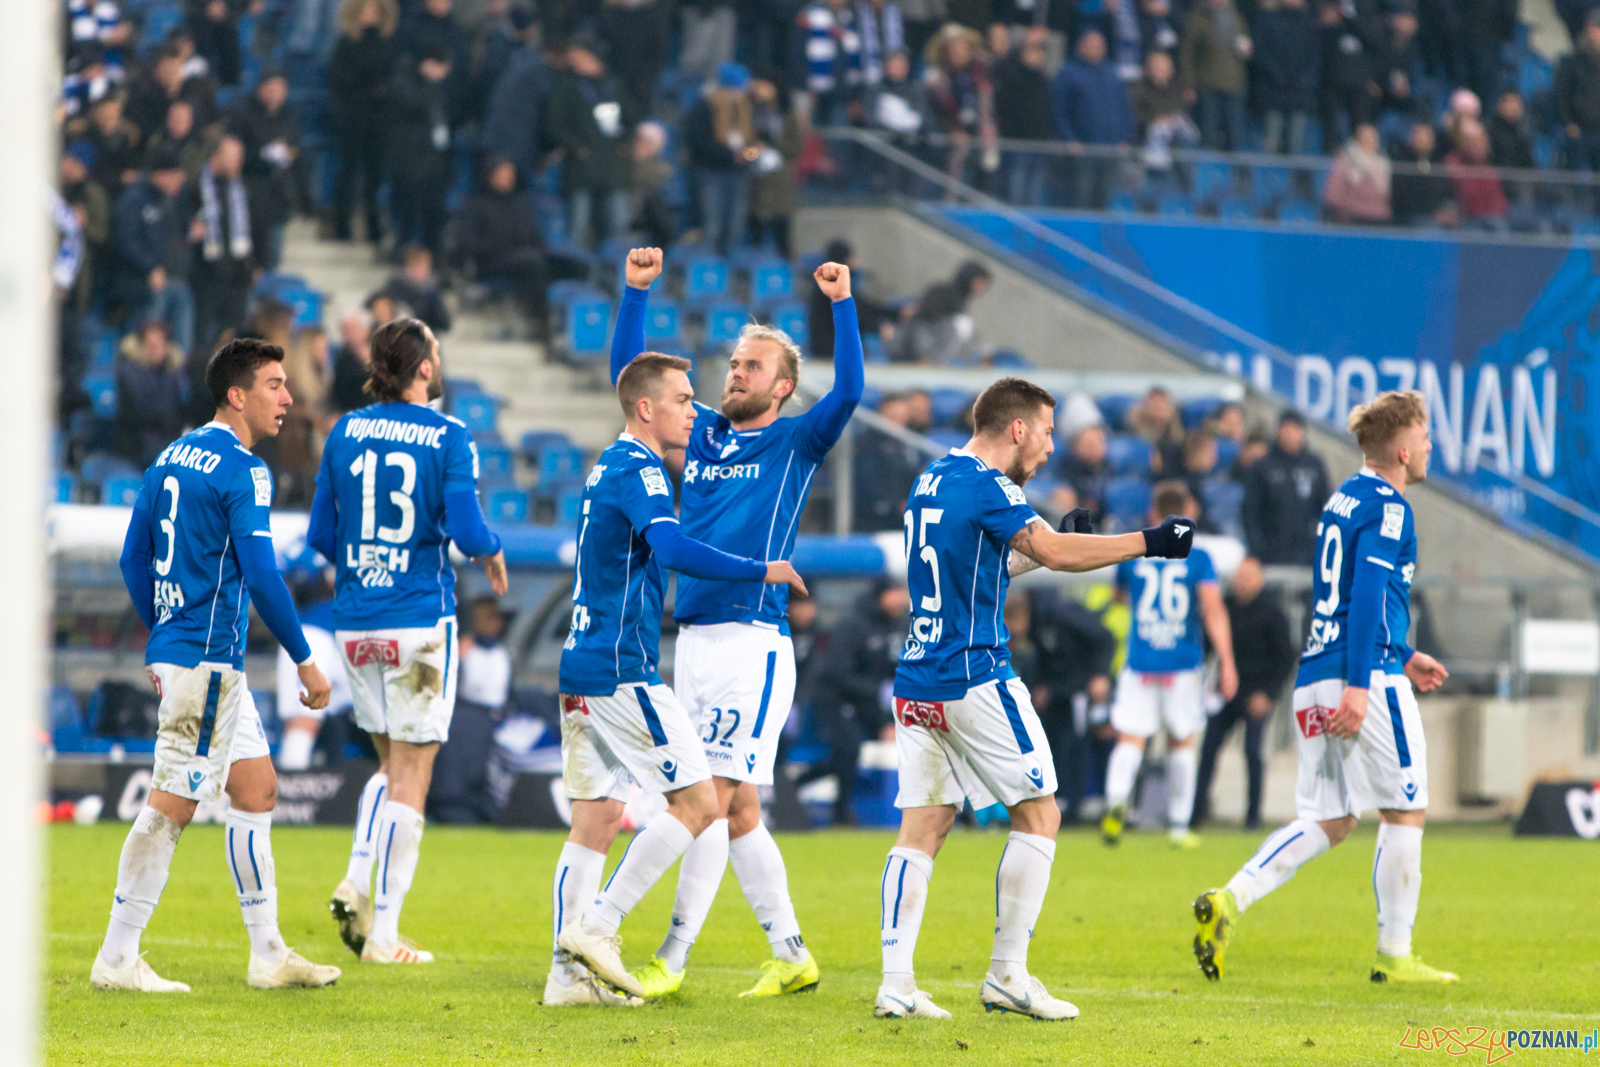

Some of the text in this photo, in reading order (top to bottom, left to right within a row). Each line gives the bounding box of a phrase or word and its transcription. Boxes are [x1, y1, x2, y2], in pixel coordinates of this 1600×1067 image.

[345, 417, 447, 449] VUJADINOVIĆ
[168, 443, 221, 474] MARCO
[701, 463, 760, 481] AFORTI
[349, 448, 417, 544] 13
[155, 475, 180, 576] 3
[346, 543, 410, 573] LECH
[1134, 563, 1190, 623] 26
[702, 707, 741, 748] 32
[703, 749, 733, 762] acron
